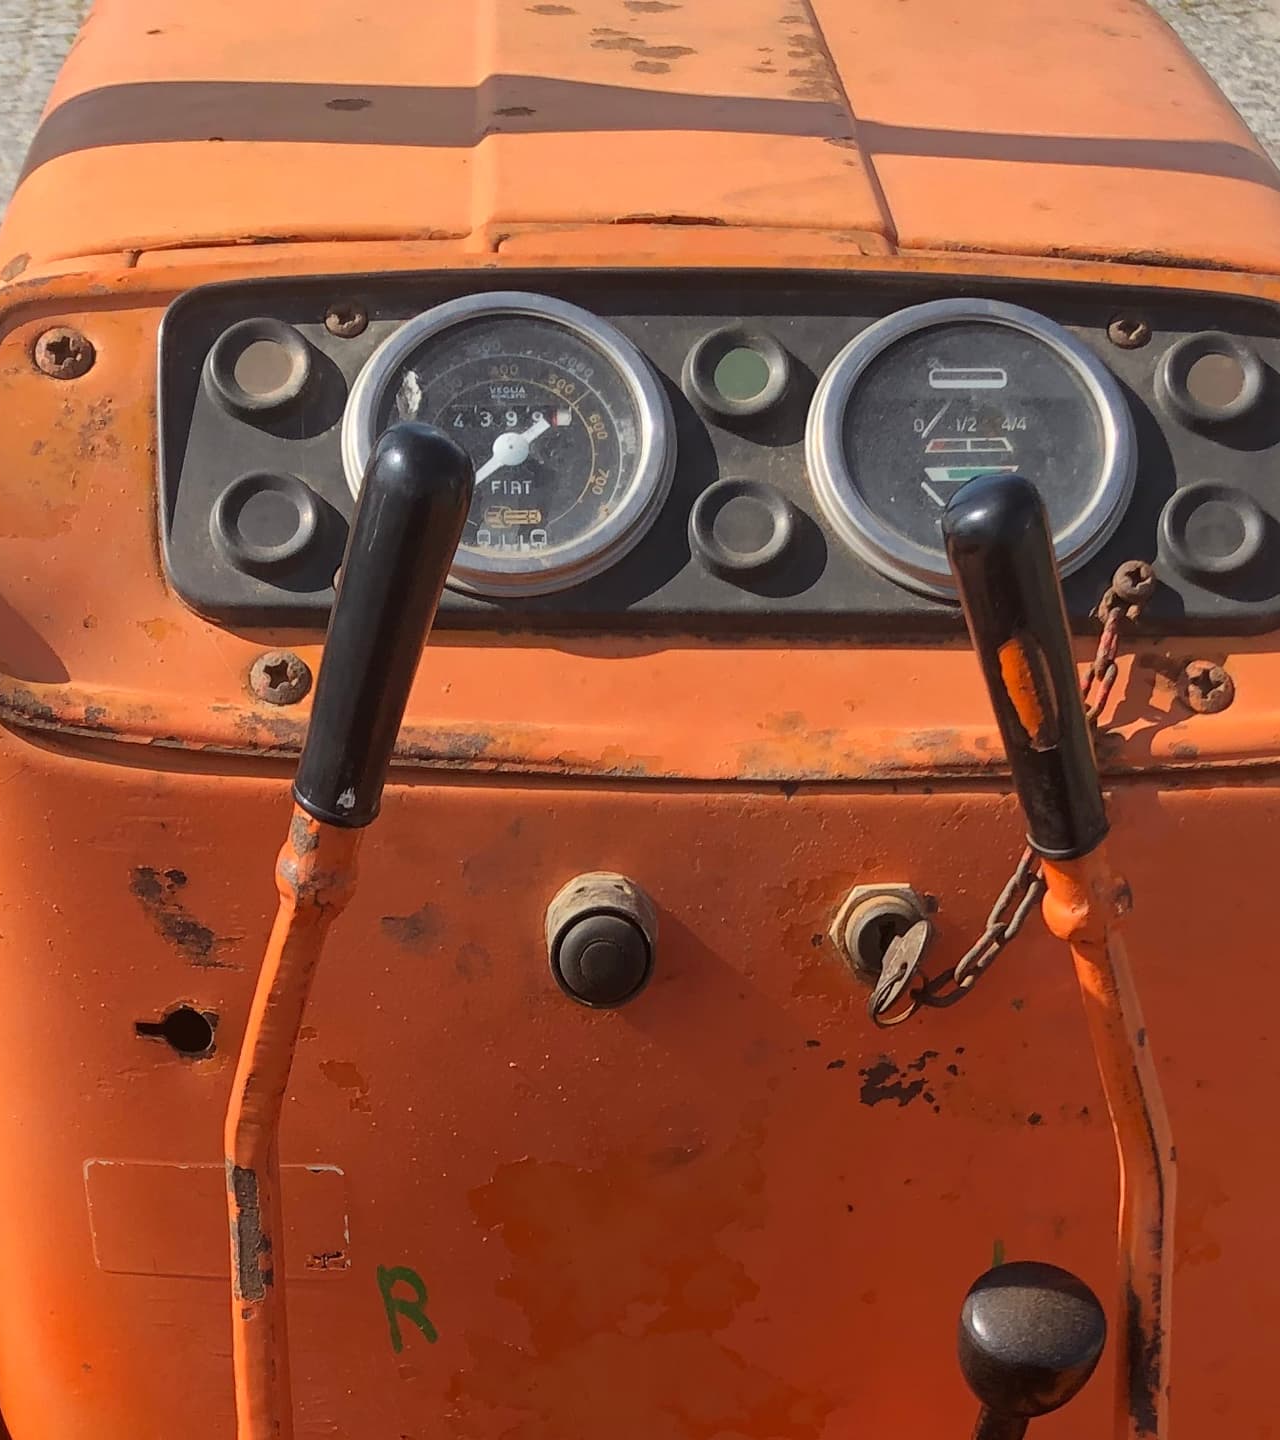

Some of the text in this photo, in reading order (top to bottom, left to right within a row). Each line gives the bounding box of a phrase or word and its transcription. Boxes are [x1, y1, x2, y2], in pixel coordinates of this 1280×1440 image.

[548, 374, 575, 395] 500
[589, 413, 609, 441] 600
[956, 417, 977, 432] 1/2
[1001, 416, 1027, 432] 4/4
[491, 480, 533, 495] FIAT
[592, 467, 611, 496] 700
[377, 1264, 439, 1355] R
